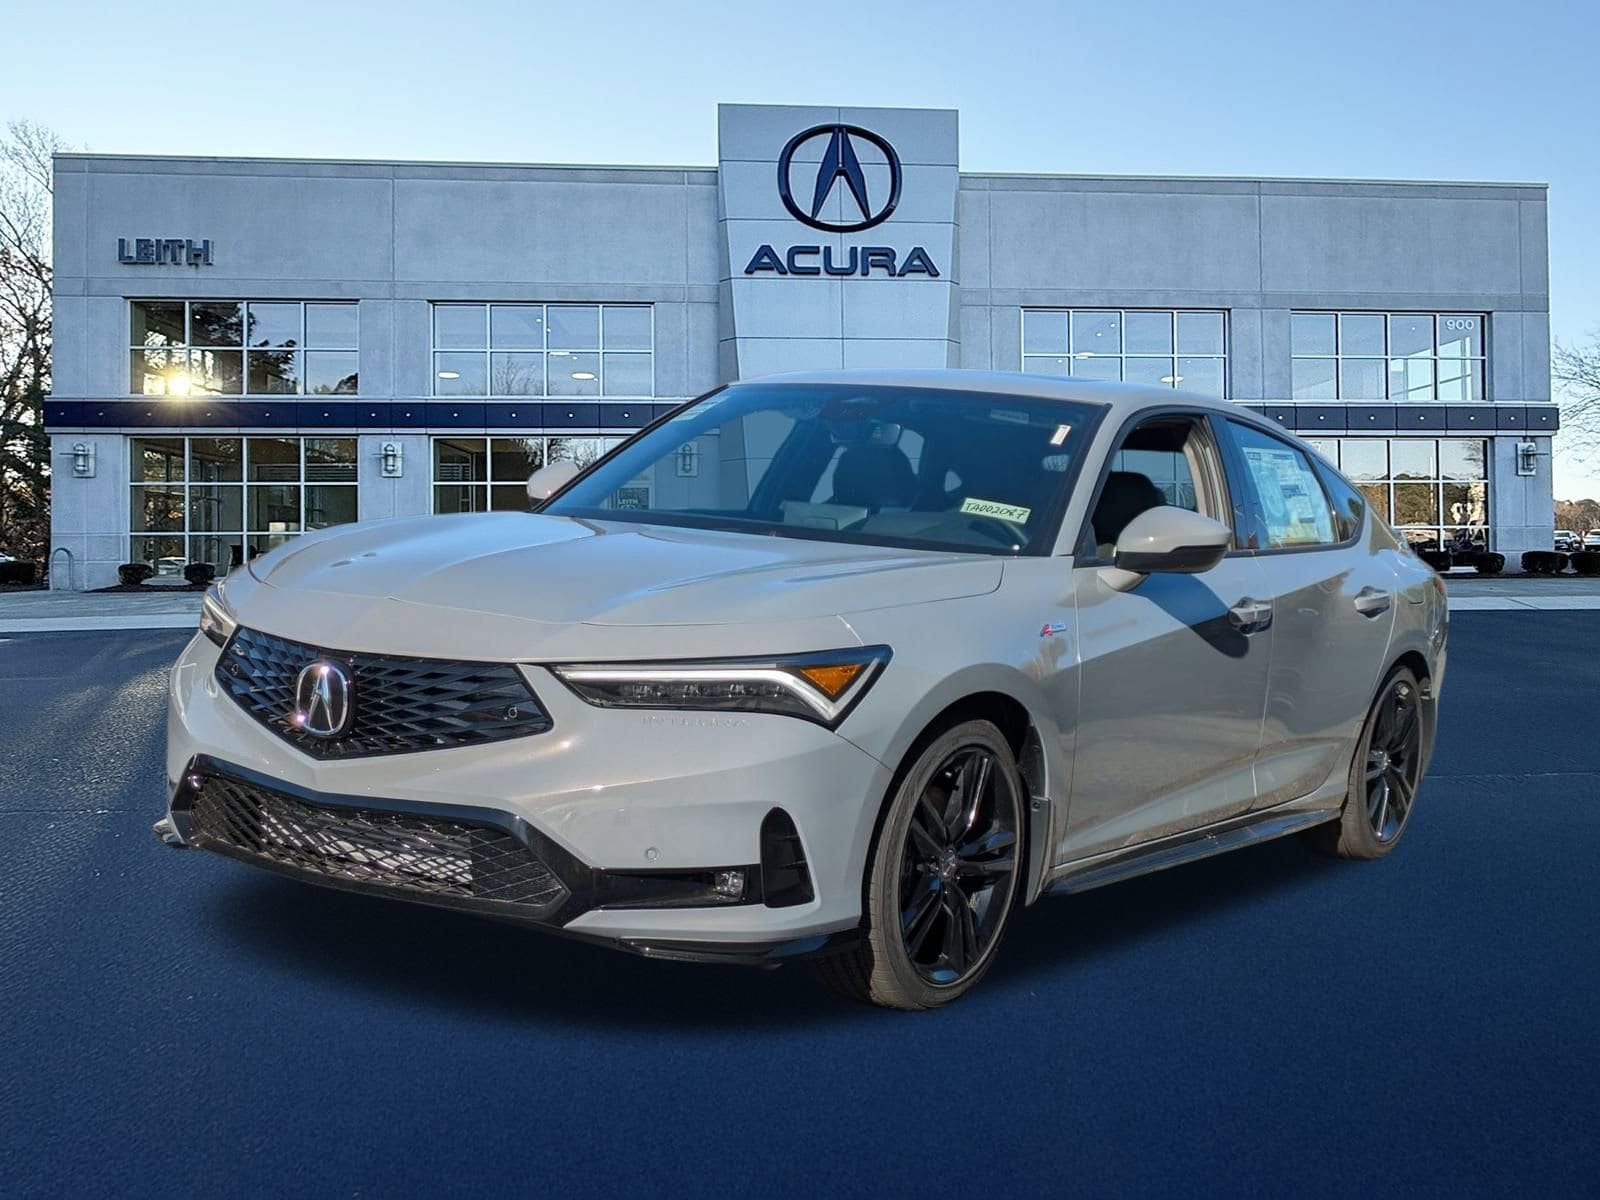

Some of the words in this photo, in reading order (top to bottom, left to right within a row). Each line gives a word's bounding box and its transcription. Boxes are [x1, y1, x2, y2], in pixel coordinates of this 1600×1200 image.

[117, 238, 212, 264] LEITH
[744, 244, 940, 277] ACURA
[1446, 319, 1474, 330] 900
